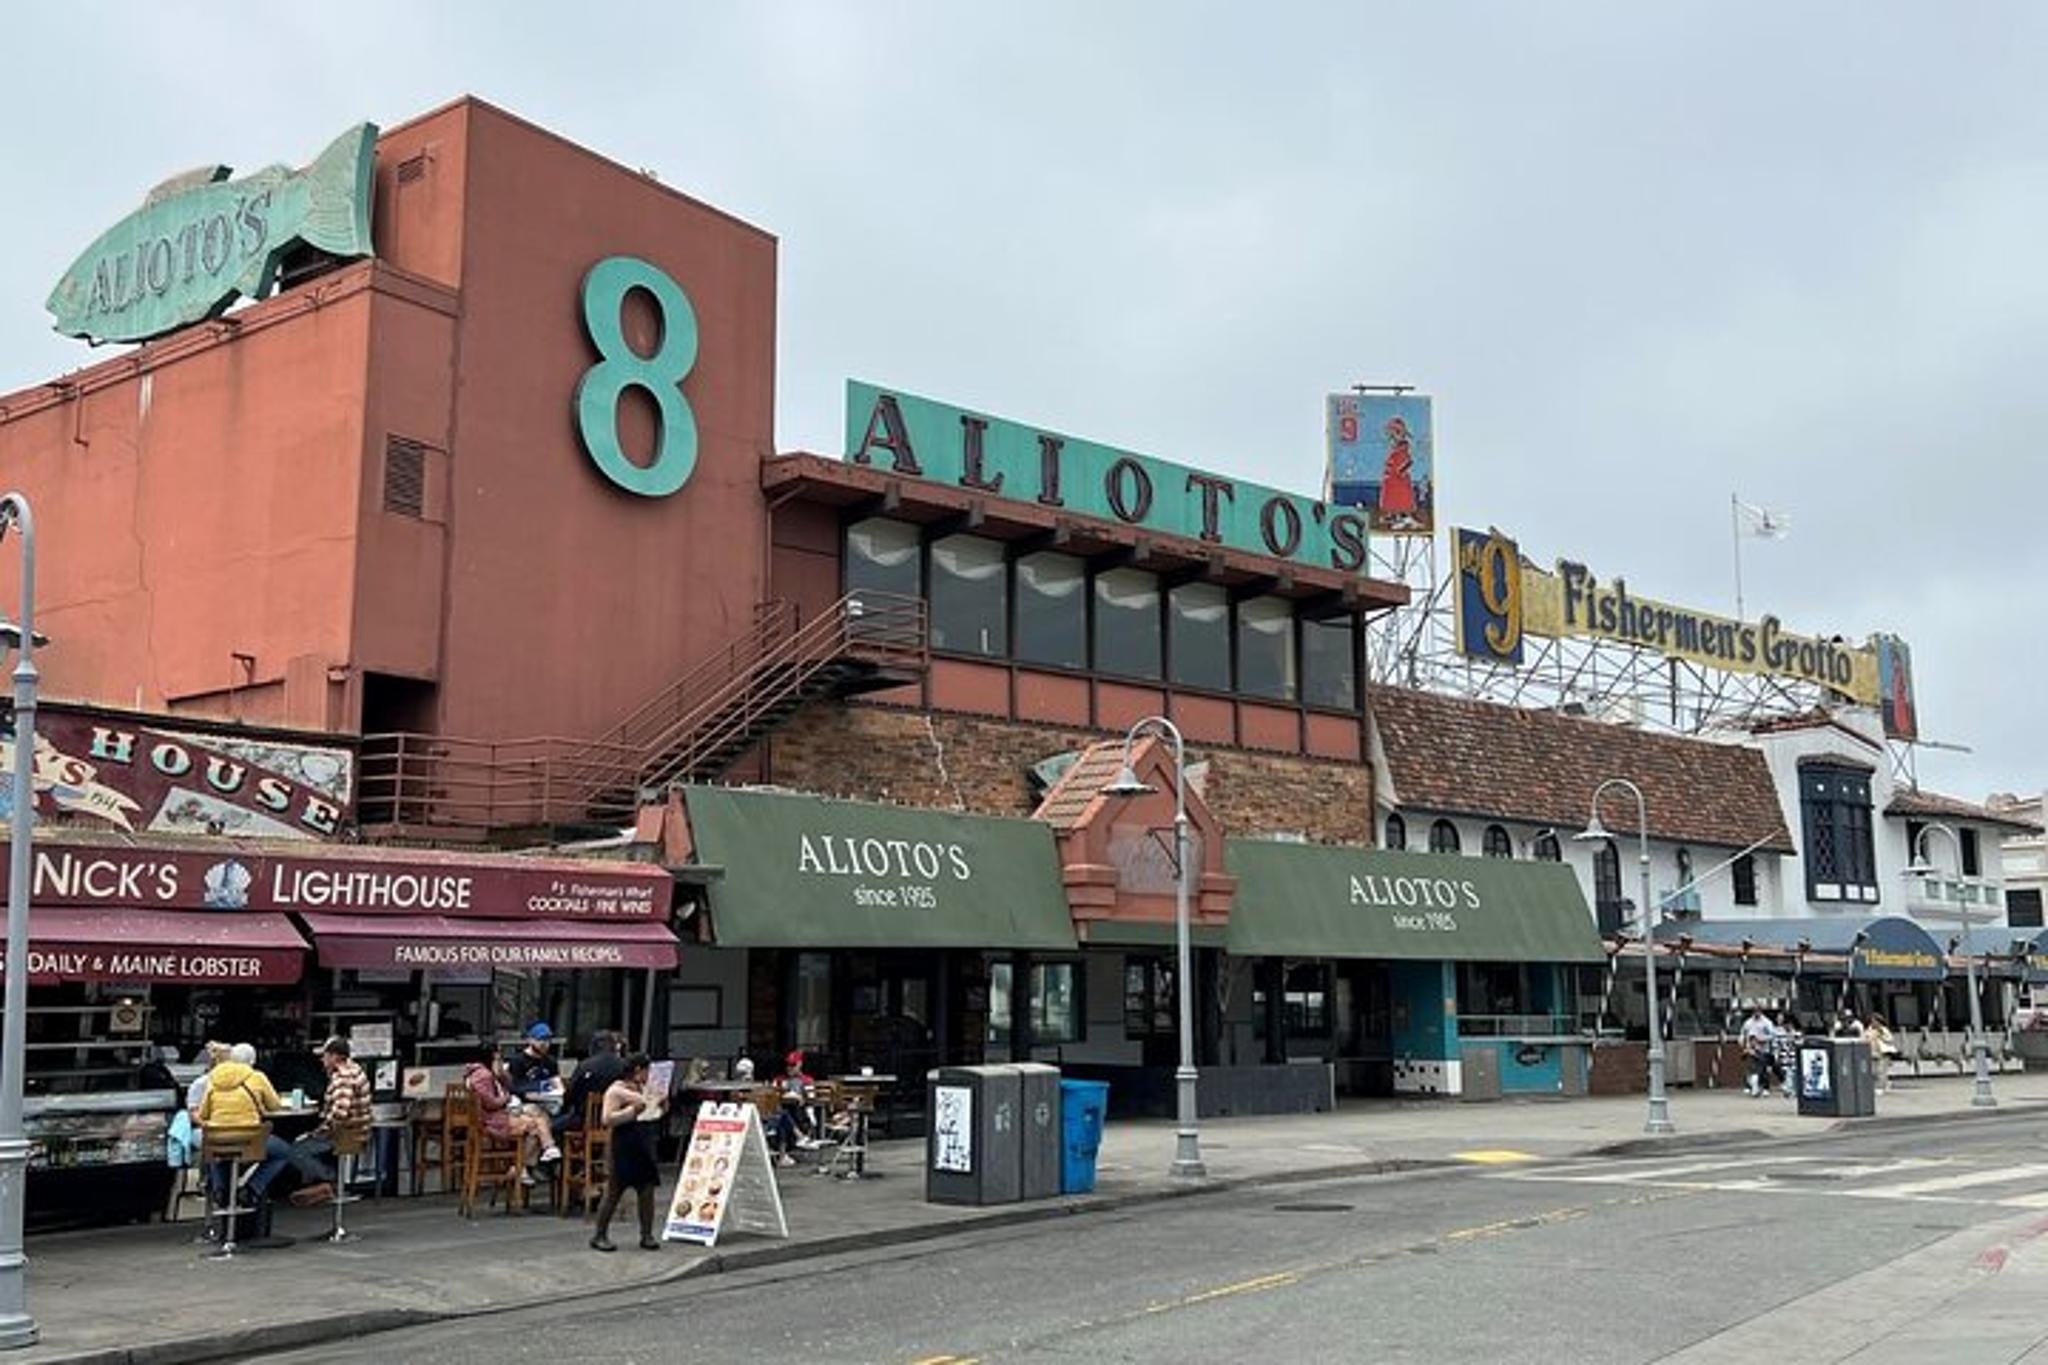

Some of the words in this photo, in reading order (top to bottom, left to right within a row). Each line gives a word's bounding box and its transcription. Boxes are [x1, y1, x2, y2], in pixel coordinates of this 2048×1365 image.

[85, 191, 271, 320] ALIOTO'S
[574, 255, 699, 497] 8
[1340, 417, 1360, 443] 9
[853, 394, 1367, 572] ALIOTO'S
[1480, 535, 1521, 657] 9
[1556, 556, 1756, 664] Fishermen's
[1760, 614, 1854, 686] Grotto
[89, 726, 342, 836] HOUSE
[33, 852, 179, 899] NICK'S
[272, 864, 473, 909] LIGHTHOUSE
[797, 833, 971, 880] ALIOTO'S
[854, 883, 897, 906] since
[1350, 875, 1480, 908] ALIOTO'S
[28, 952, 87, 973] DAILY
[110, 954, 175, 975] MAINE
[181, 956, 260, 976] LOBSTER
[395, 946, 458, 963] FAMOUS
[460, 946, 490, 963] FOR
[491, 946, 525, 963] OUR
